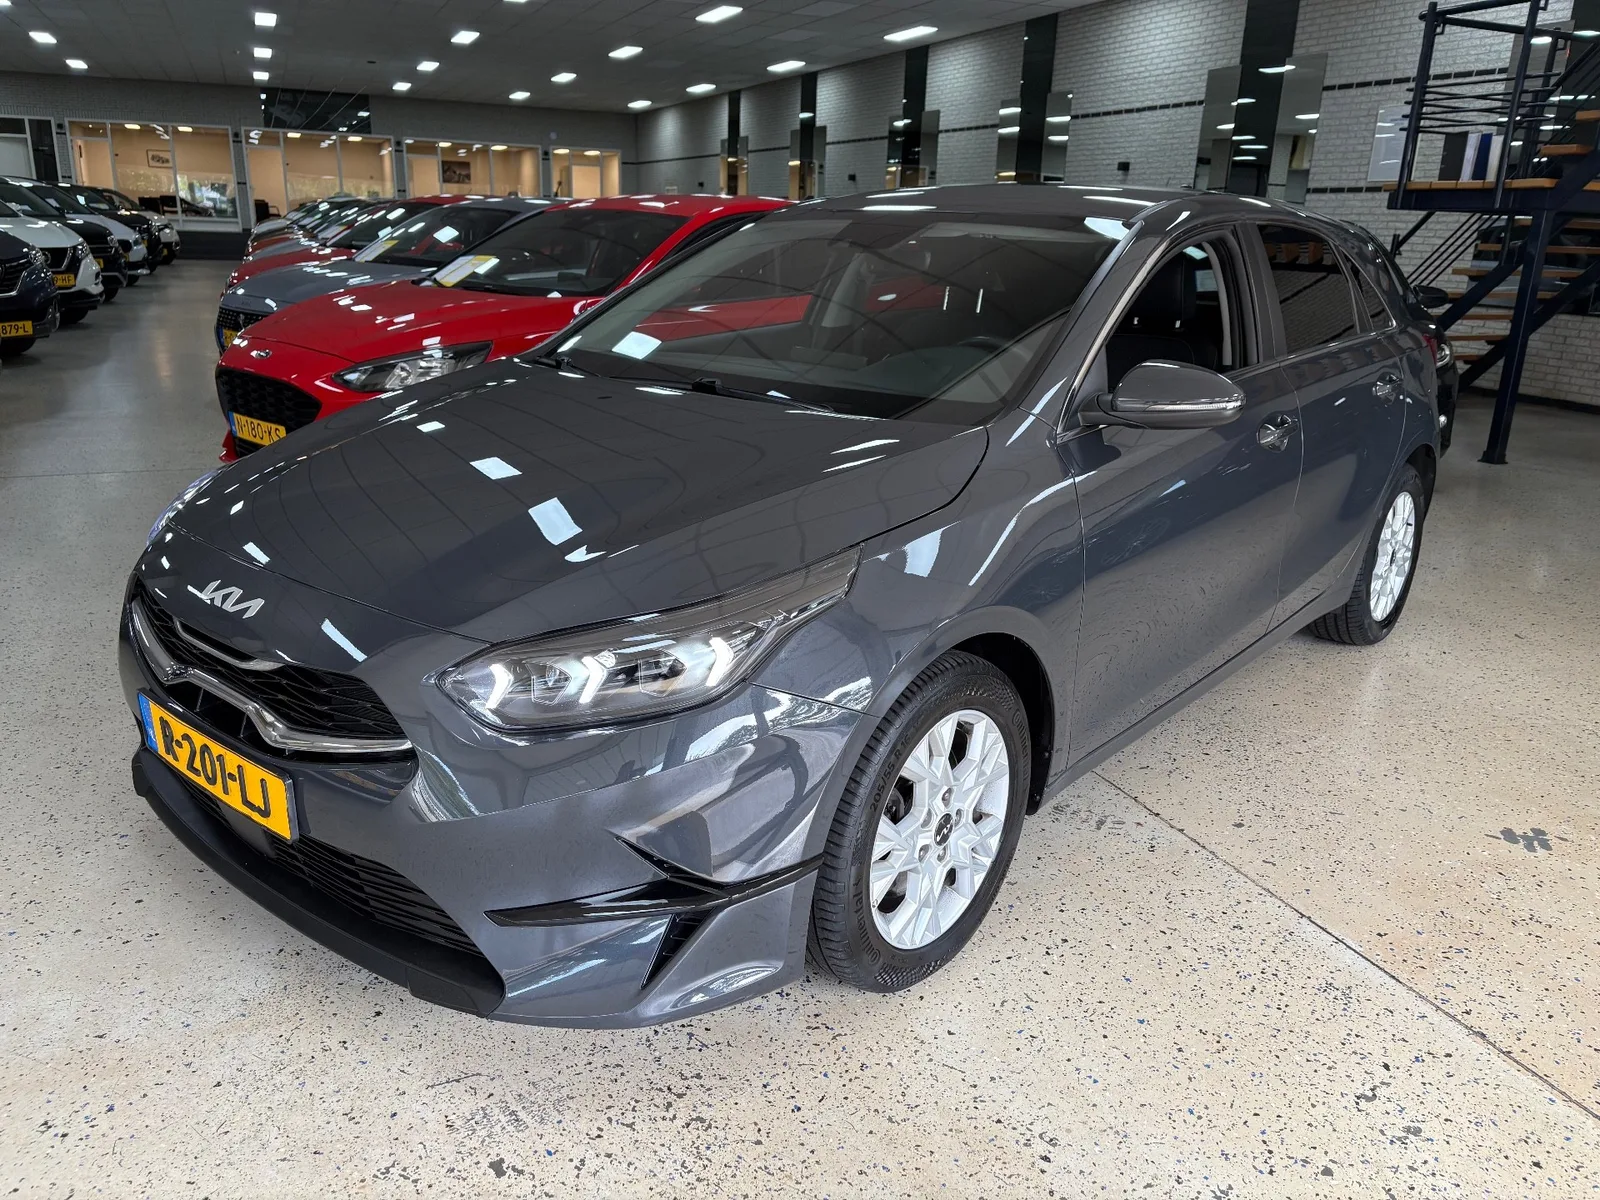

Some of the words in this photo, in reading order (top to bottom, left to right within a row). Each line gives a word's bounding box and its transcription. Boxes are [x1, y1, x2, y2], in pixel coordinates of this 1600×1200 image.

[236, 416, 281, 443] N-180-KS
[199, 580, 265, 619] KIA
[159, 715, 271, 818] R-201-LJ
[870, 763, 895, 813] 205/55
[852, 888, 881, 965] Continental
